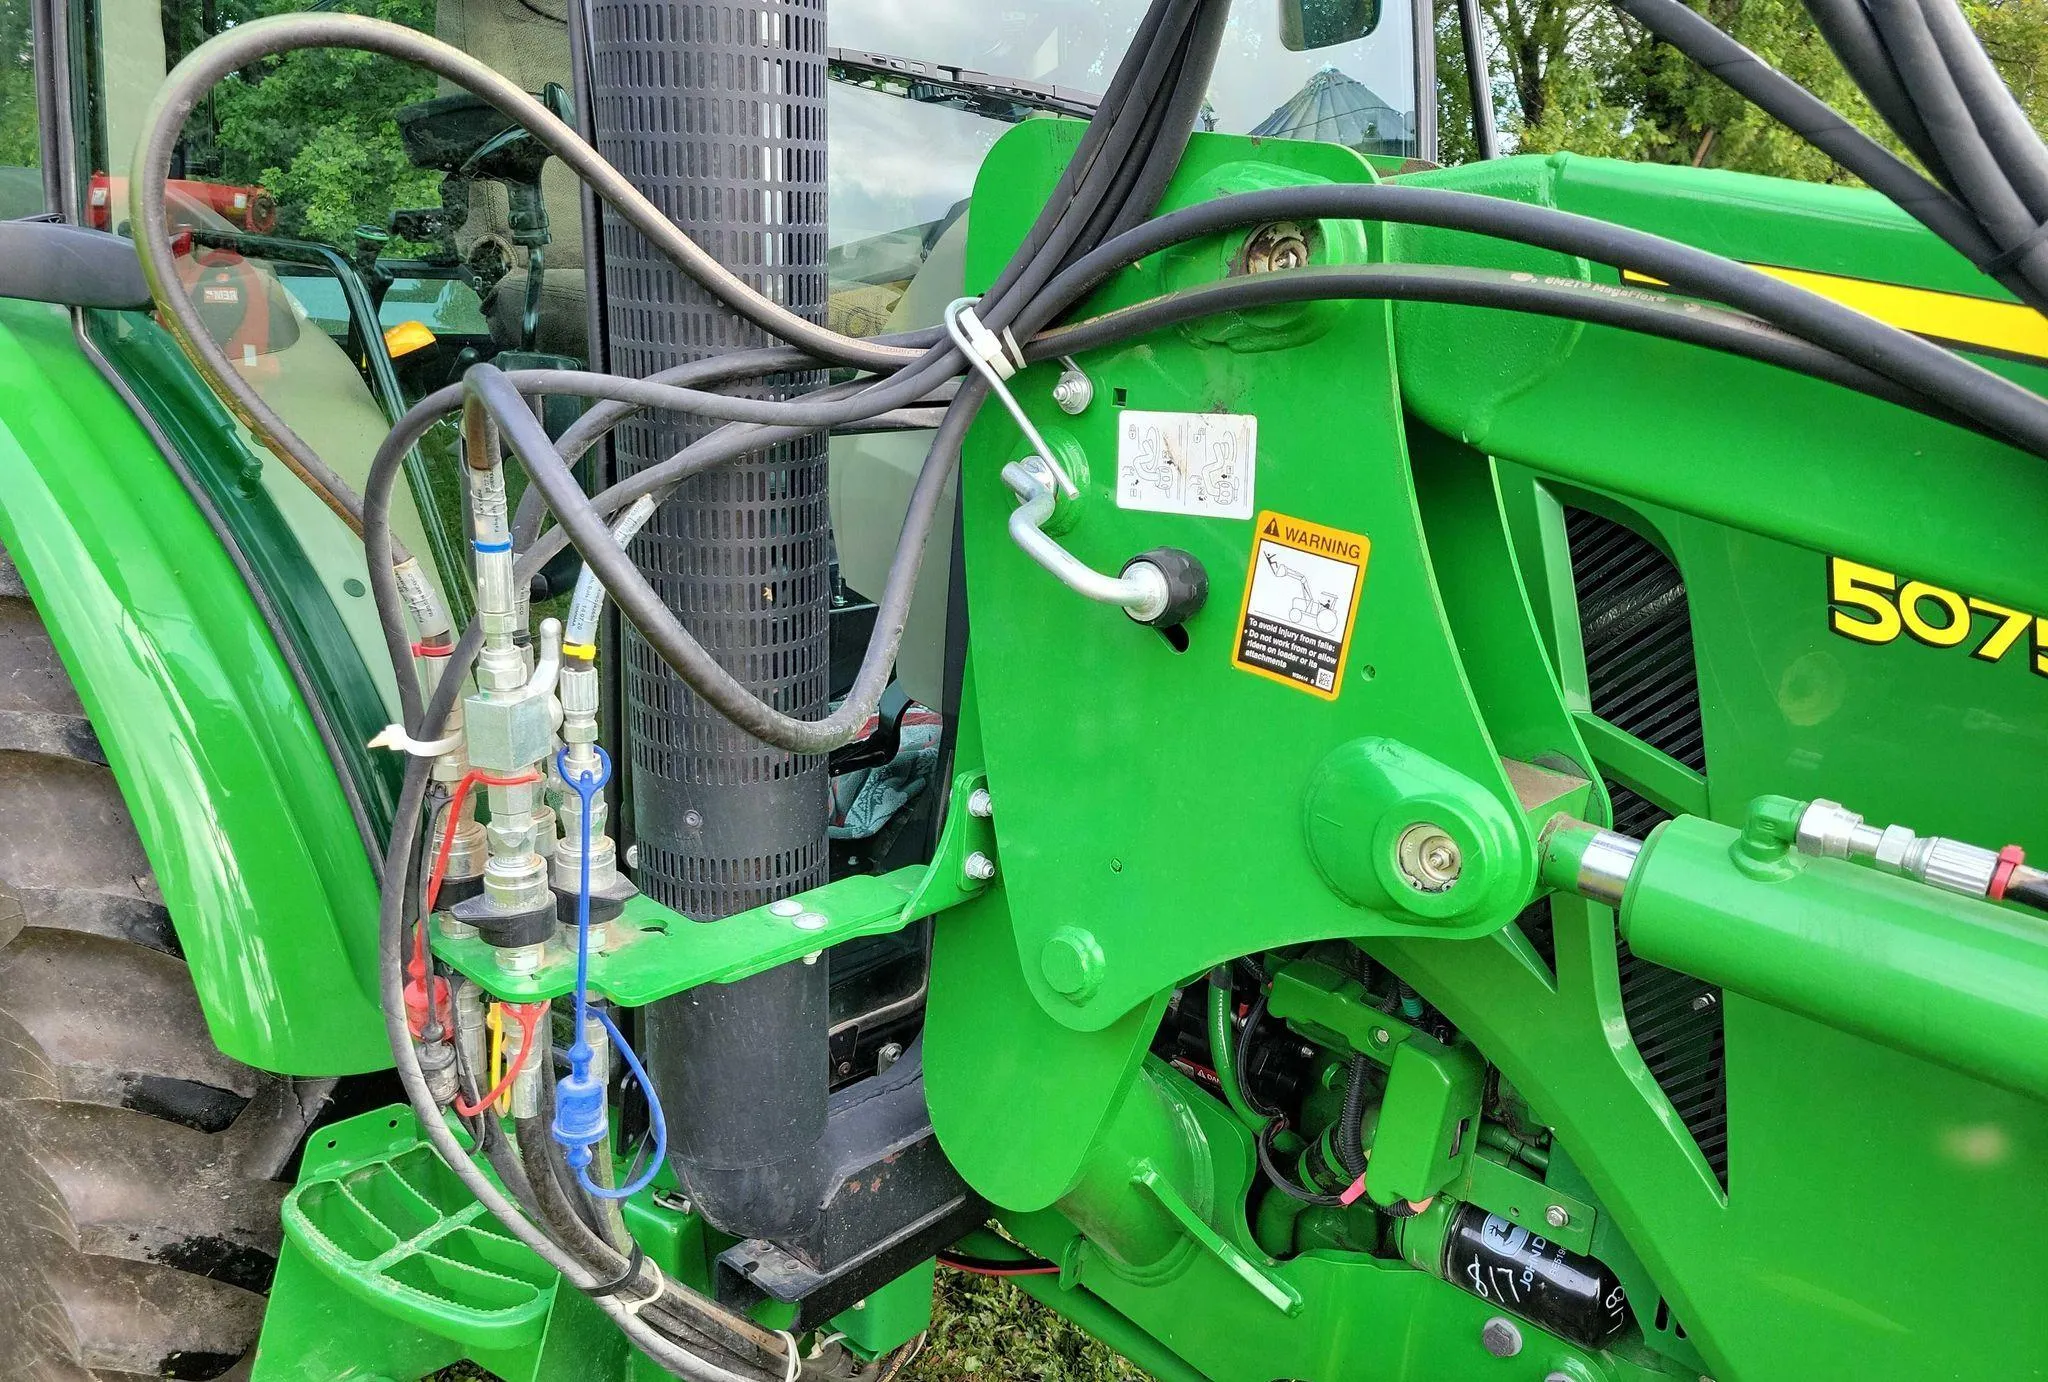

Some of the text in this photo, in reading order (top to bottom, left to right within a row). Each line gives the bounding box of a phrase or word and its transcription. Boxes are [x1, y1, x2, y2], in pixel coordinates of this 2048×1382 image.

[1285, 526, 1361, 559] WARNING
[1249, 617, 1258, 627] To
[1258, 622, 1278, 634] avoid
[1278, 627, 1299, 641] injury
[1300, 633, 1317, 646] from
[1826, 555, 2048, 680] 507
[1245, 649, 1287, 668] attachments
[1246, 639, 1318, 669] riders on loader or its
[1249, 629, 1338, 665] Do not work from or allow
[1519, 1248, 1544, 1292] JOHN
